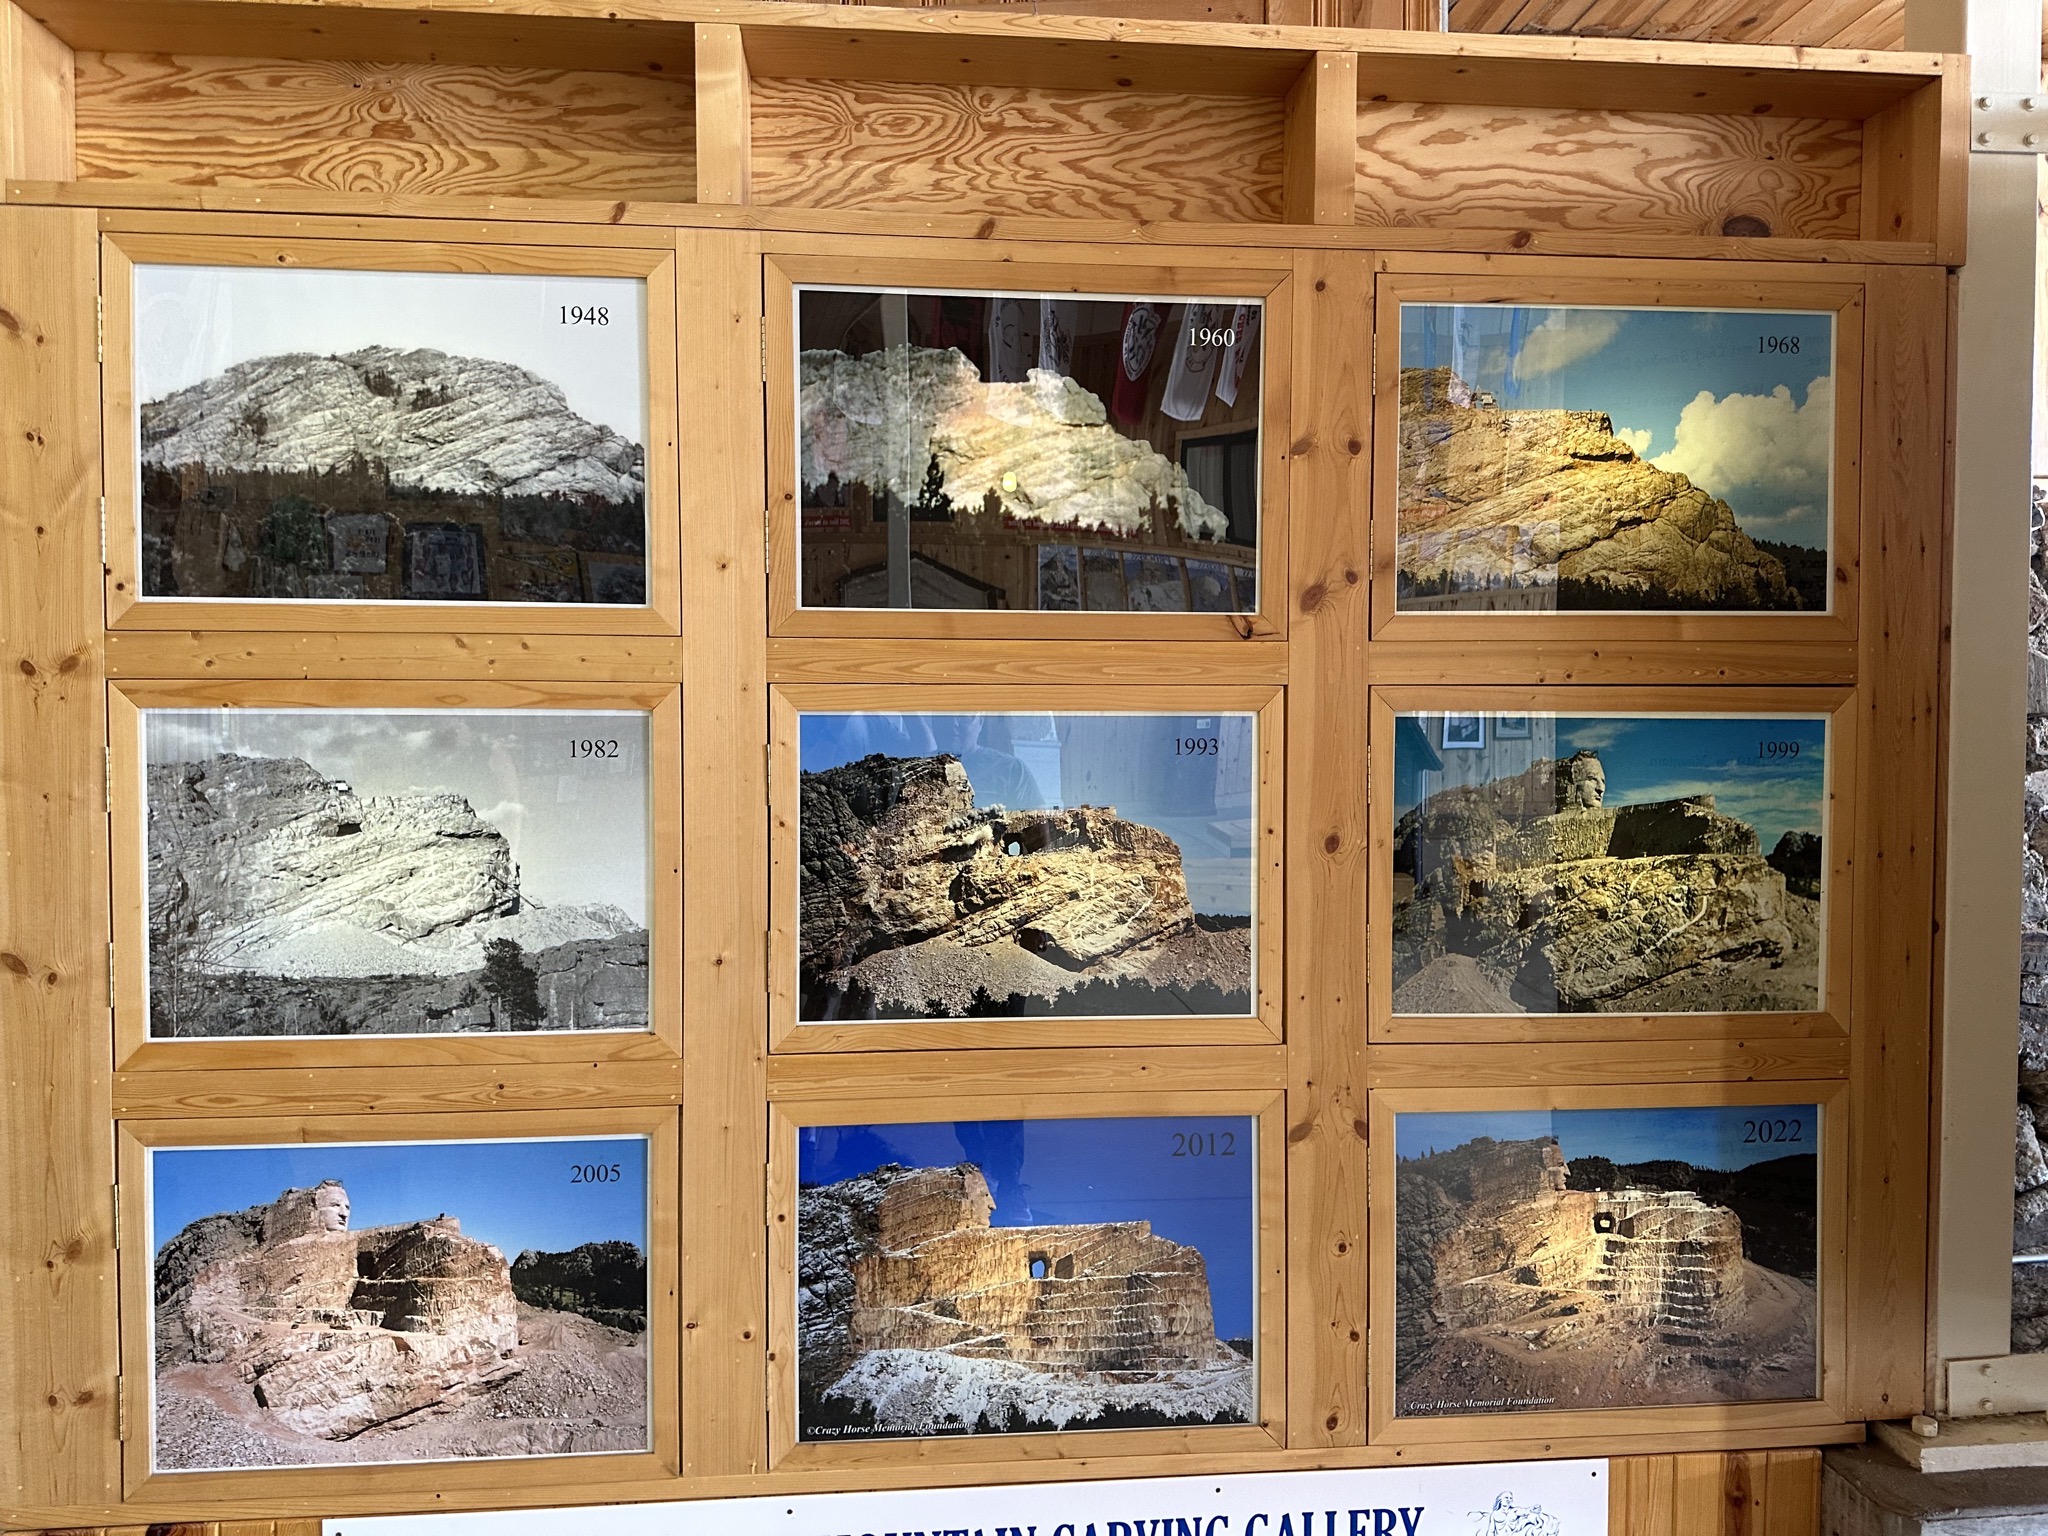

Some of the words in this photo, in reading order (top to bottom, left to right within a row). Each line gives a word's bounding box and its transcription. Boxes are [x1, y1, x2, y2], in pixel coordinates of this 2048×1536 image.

[560, 305, 610, 327] 1948
[1188, 327, 1236, 348] 1960
[1757, 335, 1800, 355] 1968
[569, 738, 620, 759] 1982
[1174, 737, 1219, 757] 1993
[1757, 741, 1801, 761] 1999
[1742, 1118, 1803, 1144] 2022
[1170, 1131, 1237, 1158] 2012
[569, 1163, 622, 1184] 2005
[1436, 1400, 1462, 1409] Horse
[1464, 1398, 1504, 1408] Memorial
[1506, 1396, 1555, 1406] Foundation
[843, 1424, 871, 1434] Horse
[872, 1423, 916, 1433] Memorial
[918, 1421, 971, 1431] Foundation
